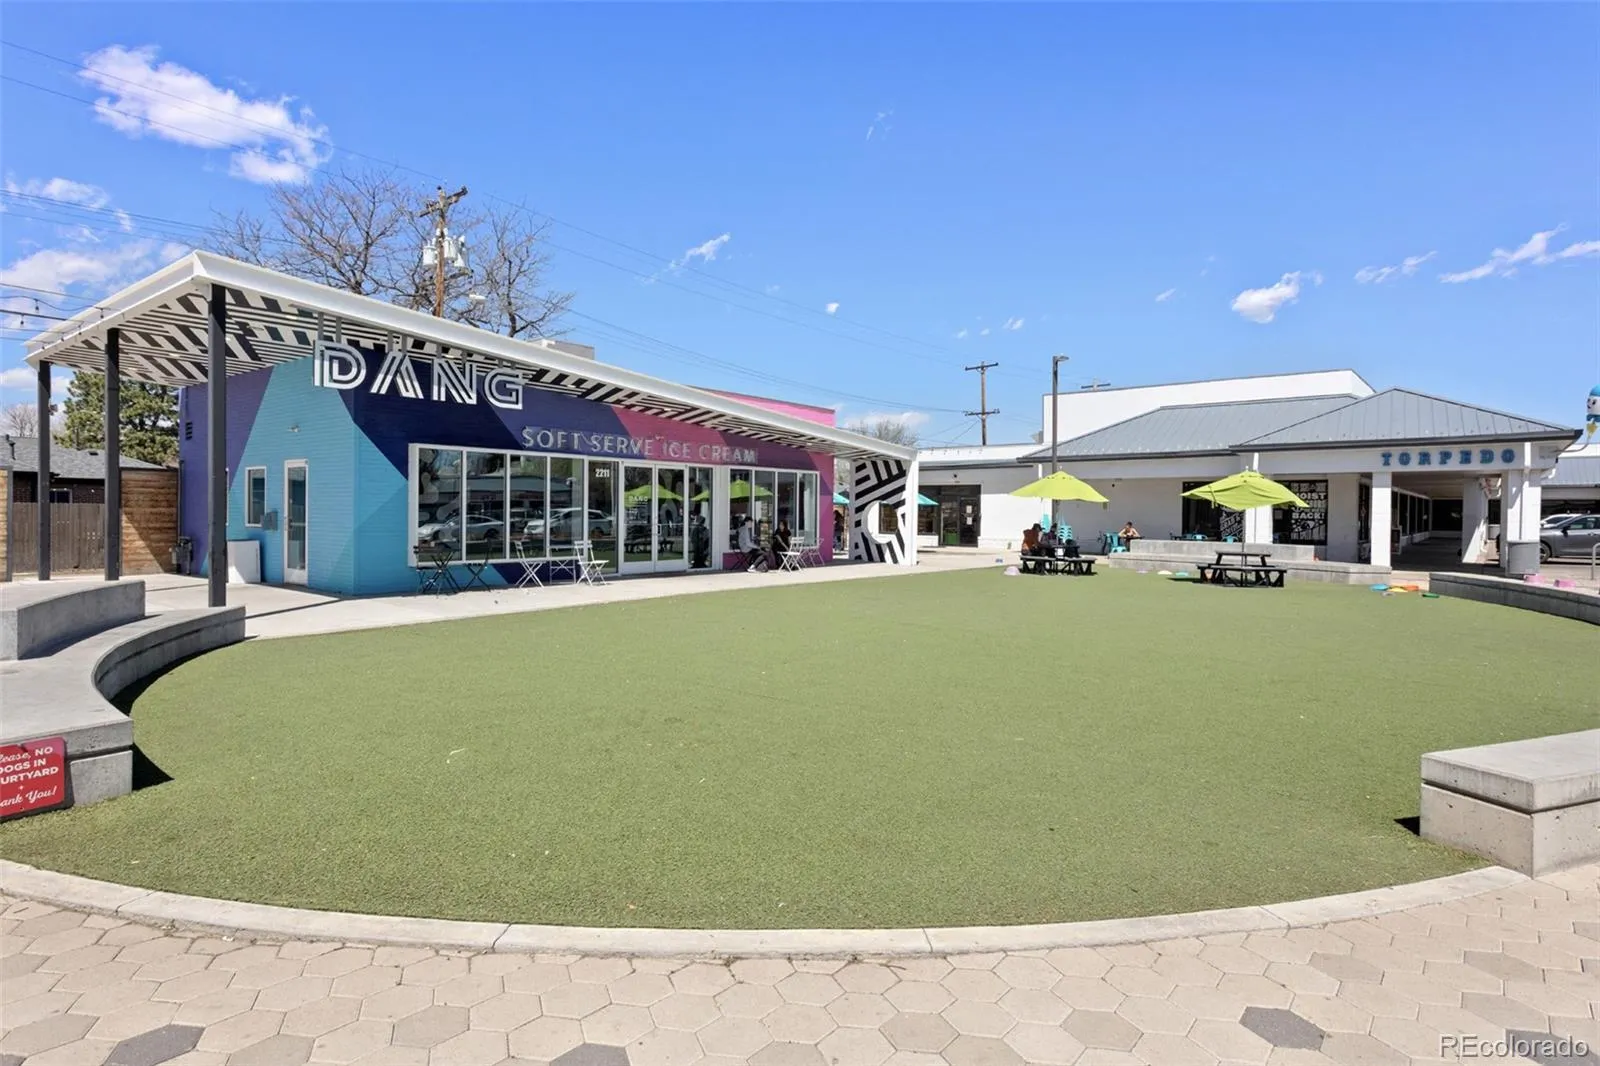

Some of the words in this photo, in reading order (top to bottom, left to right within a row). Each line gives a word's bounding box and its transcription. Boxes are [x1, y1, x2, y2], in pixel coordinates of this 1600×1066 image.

[314, 340, 523, 409] DANG
[522, 426, 581, 449] SOFT
[590, 432, 653, 456] SERVE
[662, 440, 691, 459] ICE
[699, 444, 758, 464] CREAM
[1381, 448, 1516, 467] TORPEDO
[595, 468, 610, 478] 2211
[1295, 492, 1327, 500] OIST
[1292, 512, 1325, 520] BACK!
[35, 746, 54, 757] NO
[33, 758, 47, 768] IN
[25, 785, 57, 804] You!
